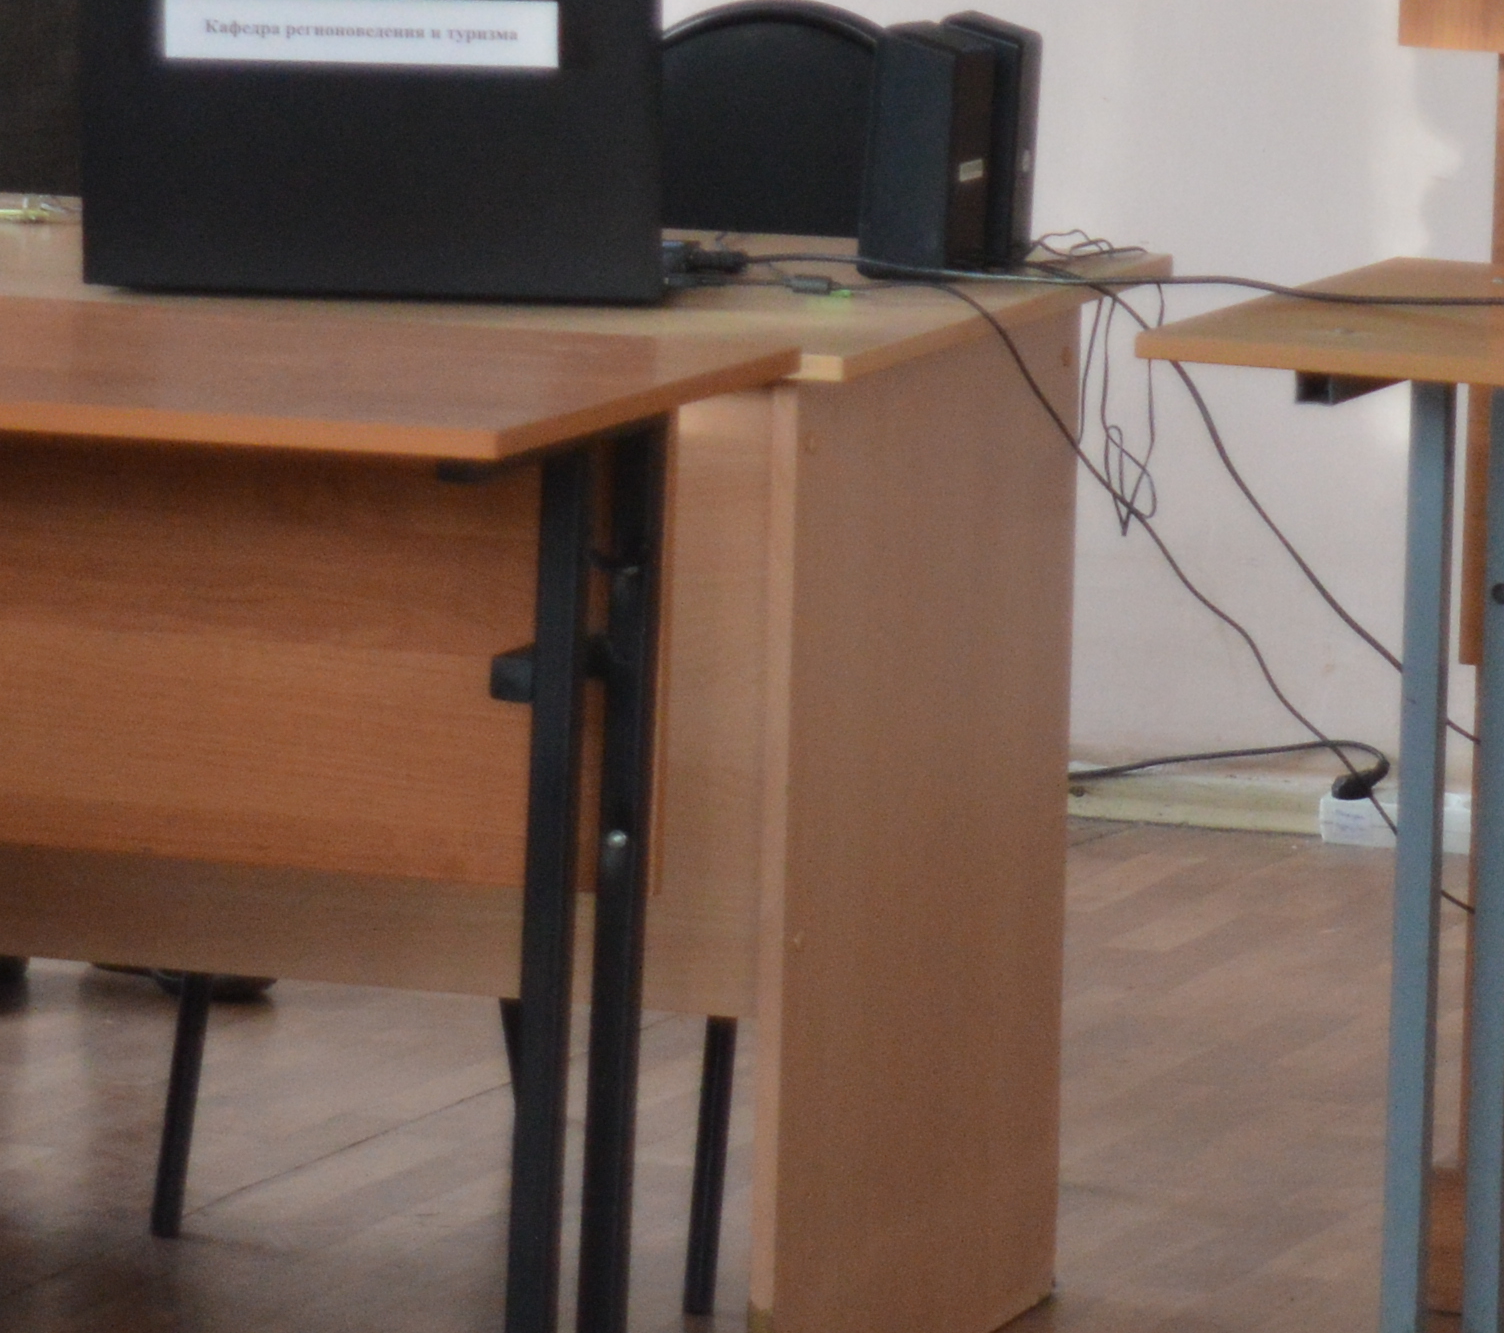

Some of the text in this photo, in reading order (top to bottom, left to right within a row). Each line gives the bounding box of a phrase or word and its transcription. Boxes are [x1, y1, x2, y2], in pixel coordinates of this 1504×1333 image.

[205, 18, 519, 44] Кафедра регионоведения и туризма
